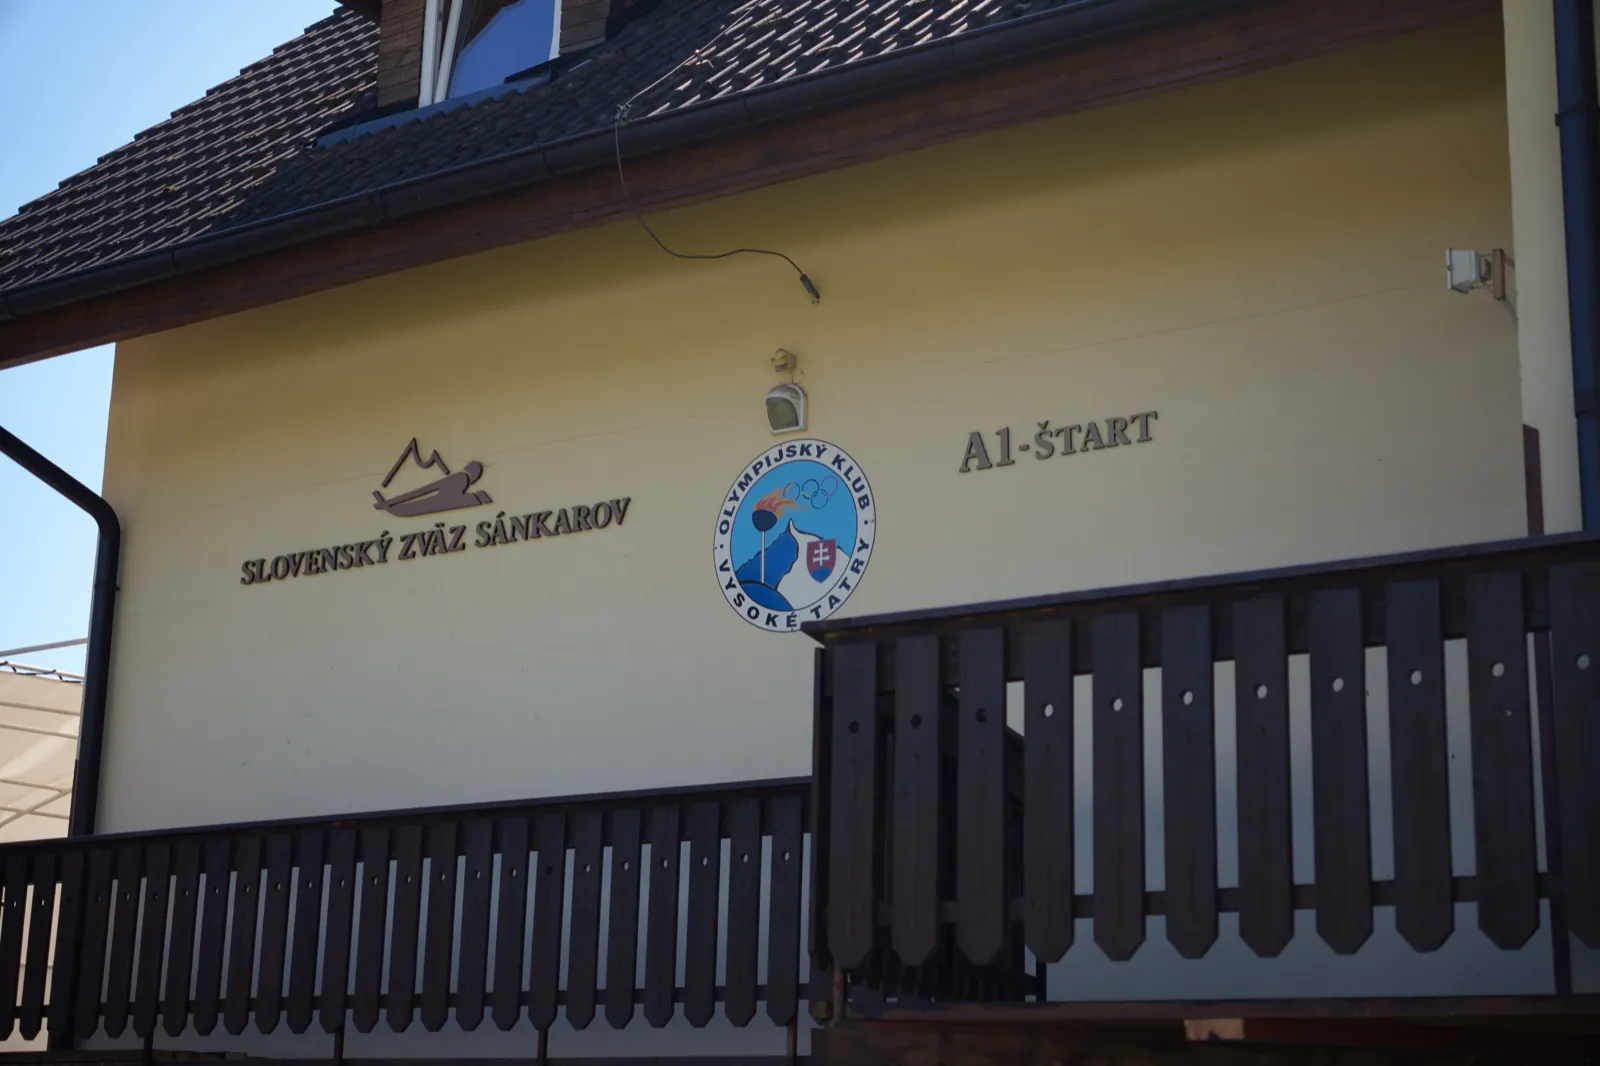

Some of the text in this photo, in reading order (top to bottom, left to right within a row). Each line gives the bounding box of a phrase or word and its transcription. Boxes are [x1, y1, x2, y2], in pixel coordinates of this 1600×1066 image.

[959, 410, 1158, 473] A1-ŠTART
[719, 443, 870, 535] OLYMPIJSKÝ KLUB
[240, 497, 632, 585] SLOVENSKÝ ZVÄZ SÁNKAROV
[719, 538, 870, 628] VYSOKÉ TATRY
